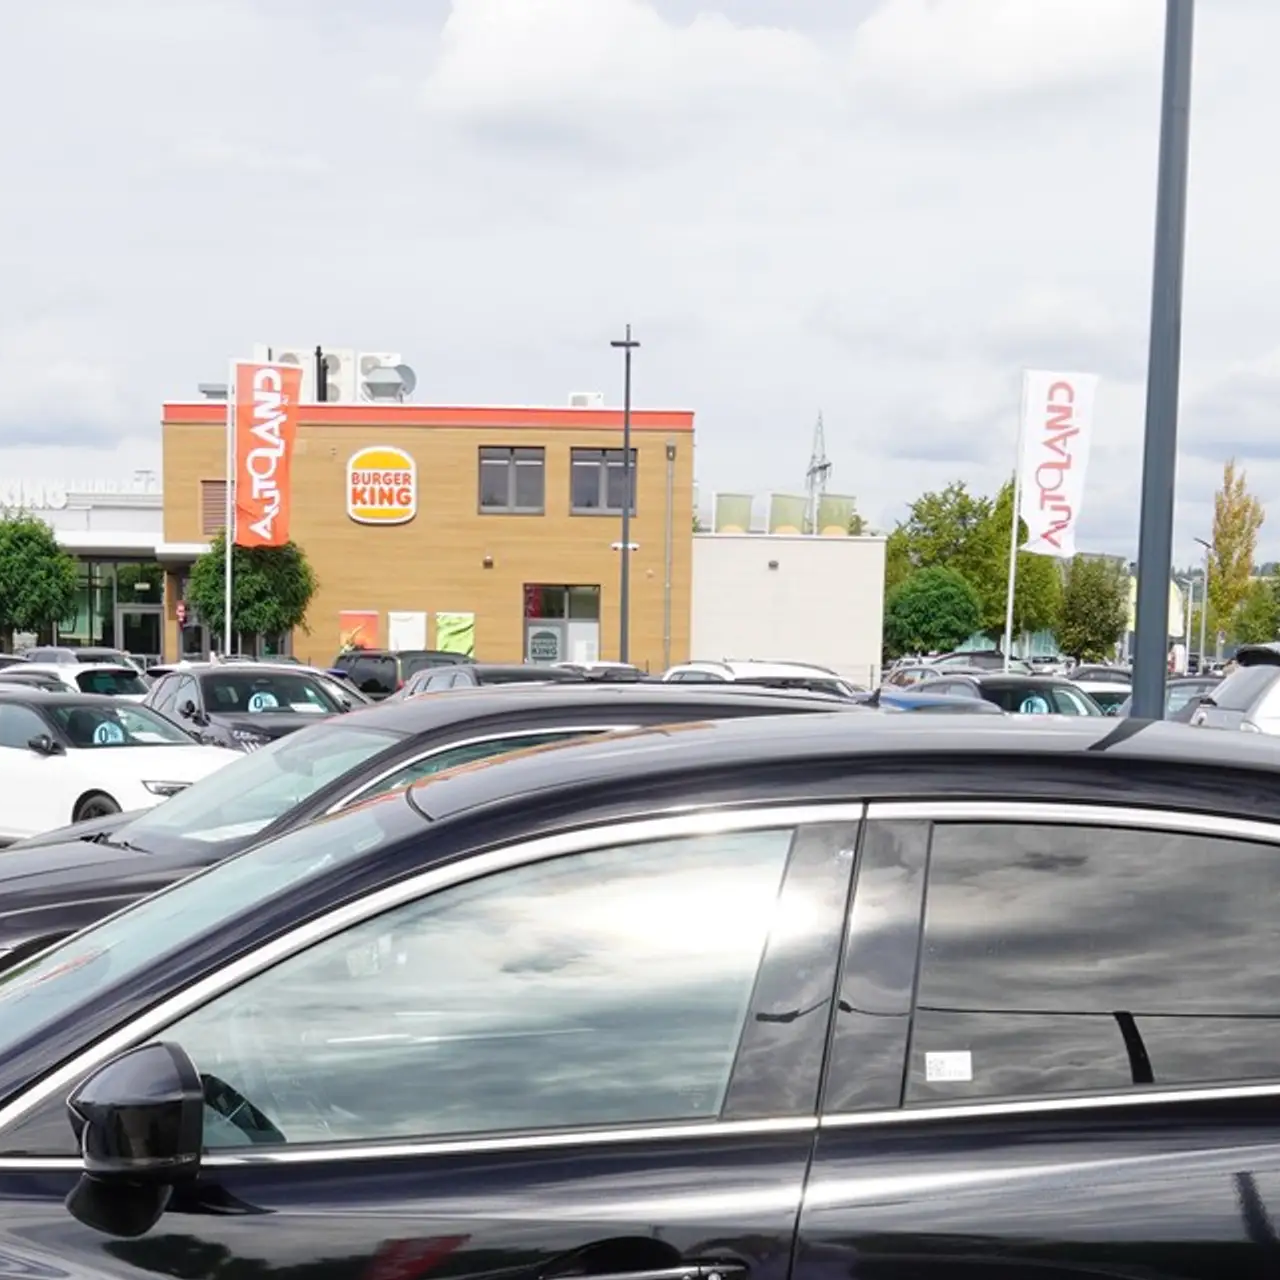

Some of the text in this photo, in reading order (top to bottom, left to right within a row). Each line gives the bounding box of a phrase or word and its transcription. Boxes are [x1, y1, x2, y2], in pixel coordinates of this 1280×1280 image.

[246, 367, 288, 541] AUTOLAND
[351, 471, 412, 486] BURGER
[351, 487, 412, 506] KING
[1034, 381, 1081, 549] AUTOLAND
